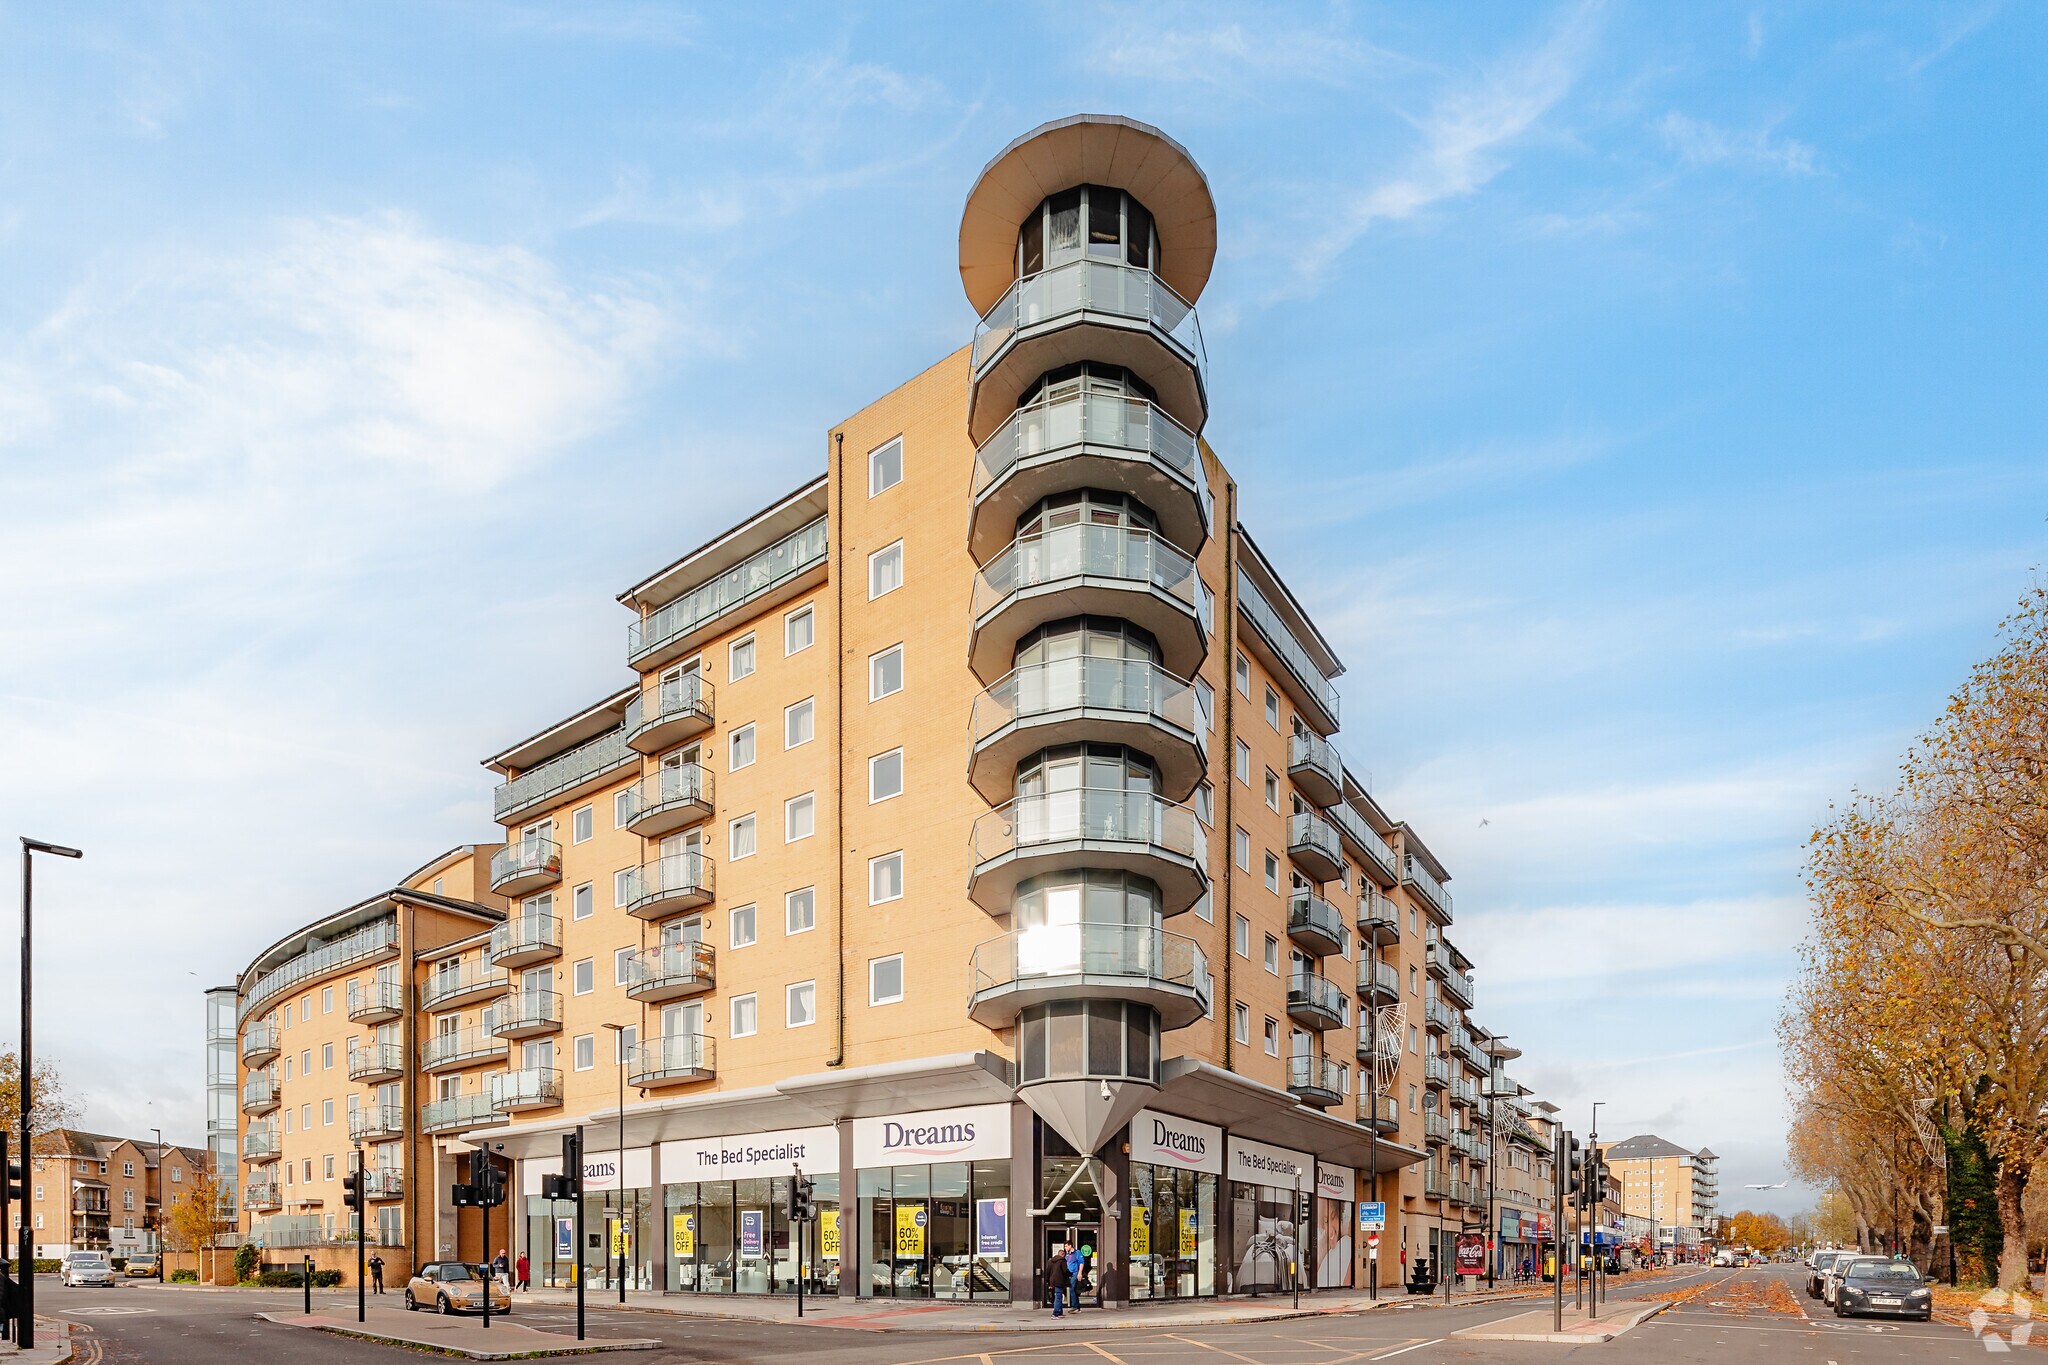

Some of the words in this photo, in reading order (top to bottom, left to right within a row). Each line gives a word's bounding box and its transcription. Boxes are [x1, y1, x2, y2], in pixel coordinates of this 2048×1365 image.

[883, 1122, 976, 1149] Dreams
[1153, 1119, 1206, 1154] Dreams
[696, 1151, 718, 1166] The
[721, 1148, 743, 1164] Bed
[746, 1143, 806, 1165] Specialist
[1238, 1151, 1252, 1167] The
[1252, 1154, 1266, 1170] Bed
[1267, 1157, 1296, 1176] Specialist
[583, 1162, 616, 1178] eams
[1318, 1166, 1345, 1188] Dreams
[675, 1231, 690, 1241] 60%
[743, 1231, 756, 1239] Free
[899, 1227, 919, 1239] 60%
[1132, 1227, 1147, 1239] 60%
[675, 1241, 690, 1251] OFF
[899, 1239, 919, 1251] OFF
[1132, 1240, 1146, 1252] OFF
